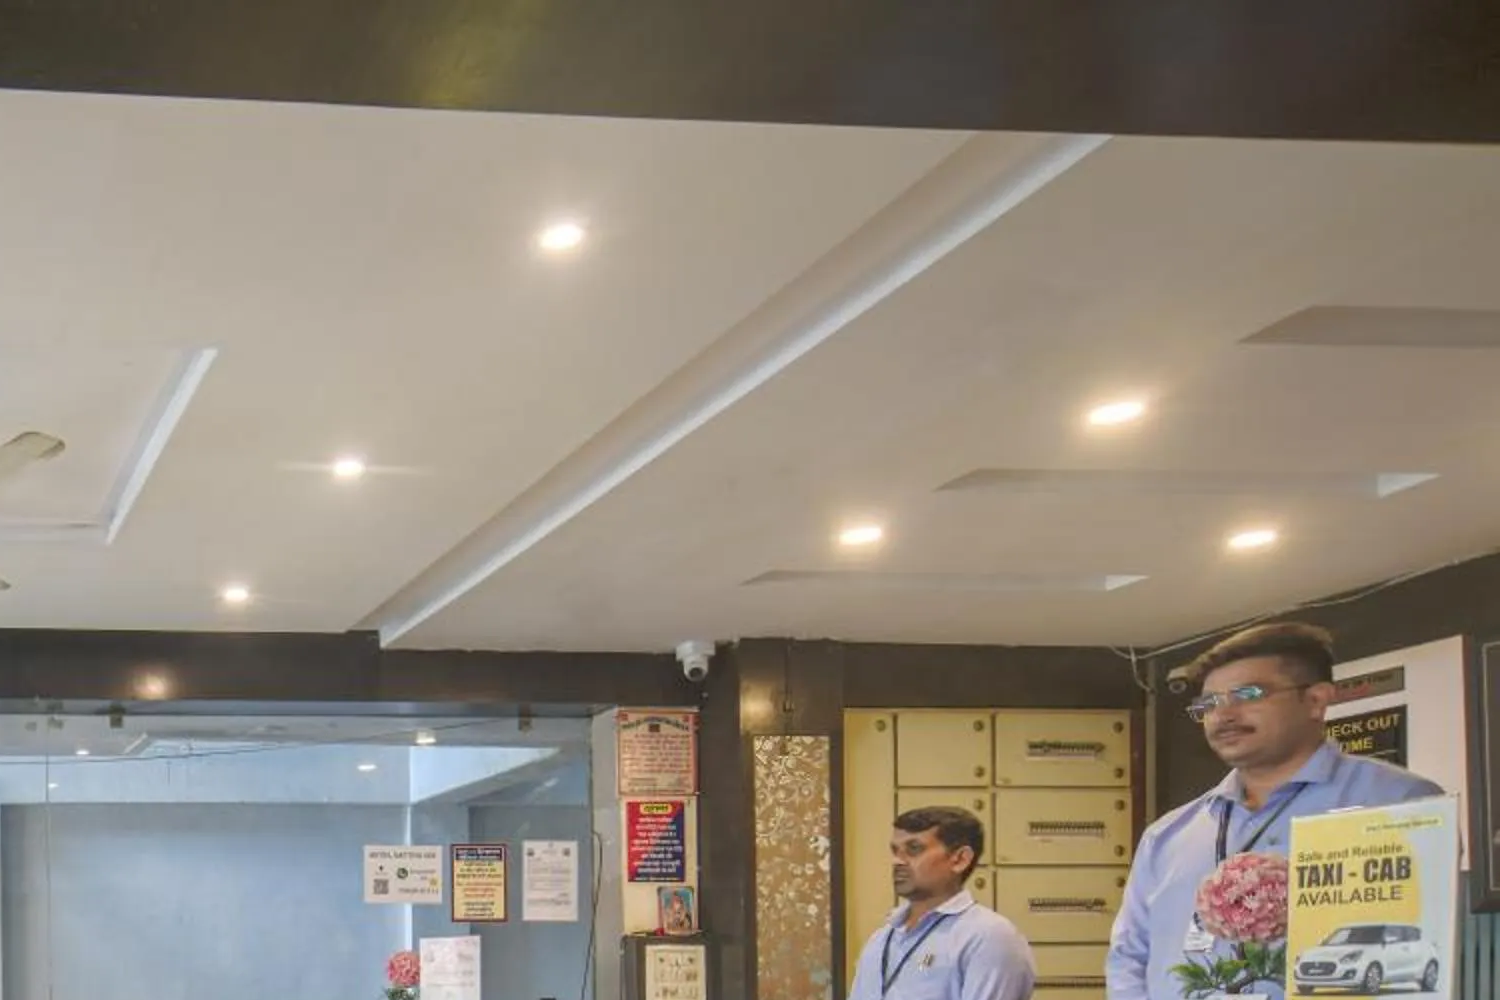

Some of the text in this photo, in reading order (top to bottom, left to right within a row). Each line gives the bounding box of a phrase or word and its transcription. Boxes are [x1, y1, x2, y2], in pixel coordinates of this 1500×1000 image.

[1327, 720, 1363, 737] ECK
[1296, 862, 1343, 888] TAXI
[1364, 856, 1411, 883] CAB
[1297, 885, 1404, 907] AVAILABLE
